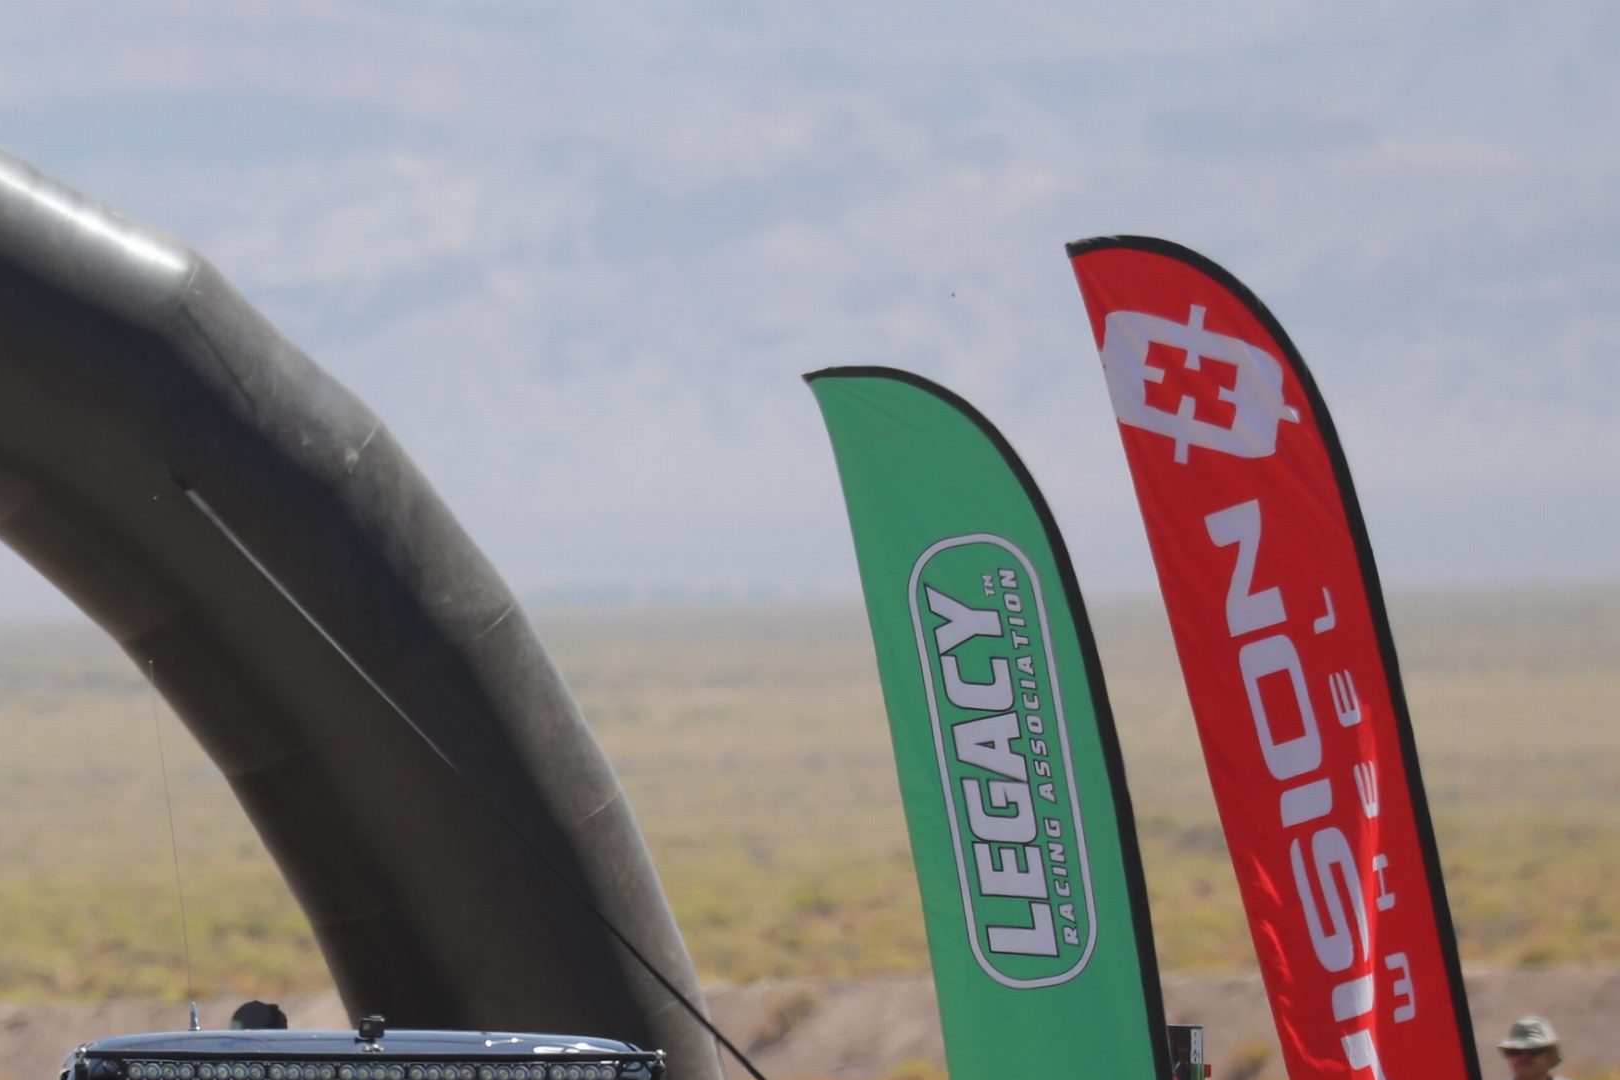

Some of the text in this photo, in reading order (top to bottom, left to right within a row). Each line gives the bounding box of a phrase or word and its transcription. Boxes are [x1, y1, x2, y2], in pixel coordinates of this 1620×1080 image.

[923, 583, 1061, 958] LEGACY
[997, 567, 1081, 948] RACING ASSOCIATION
[1313, 588, 1416, 1024] WHEEL
